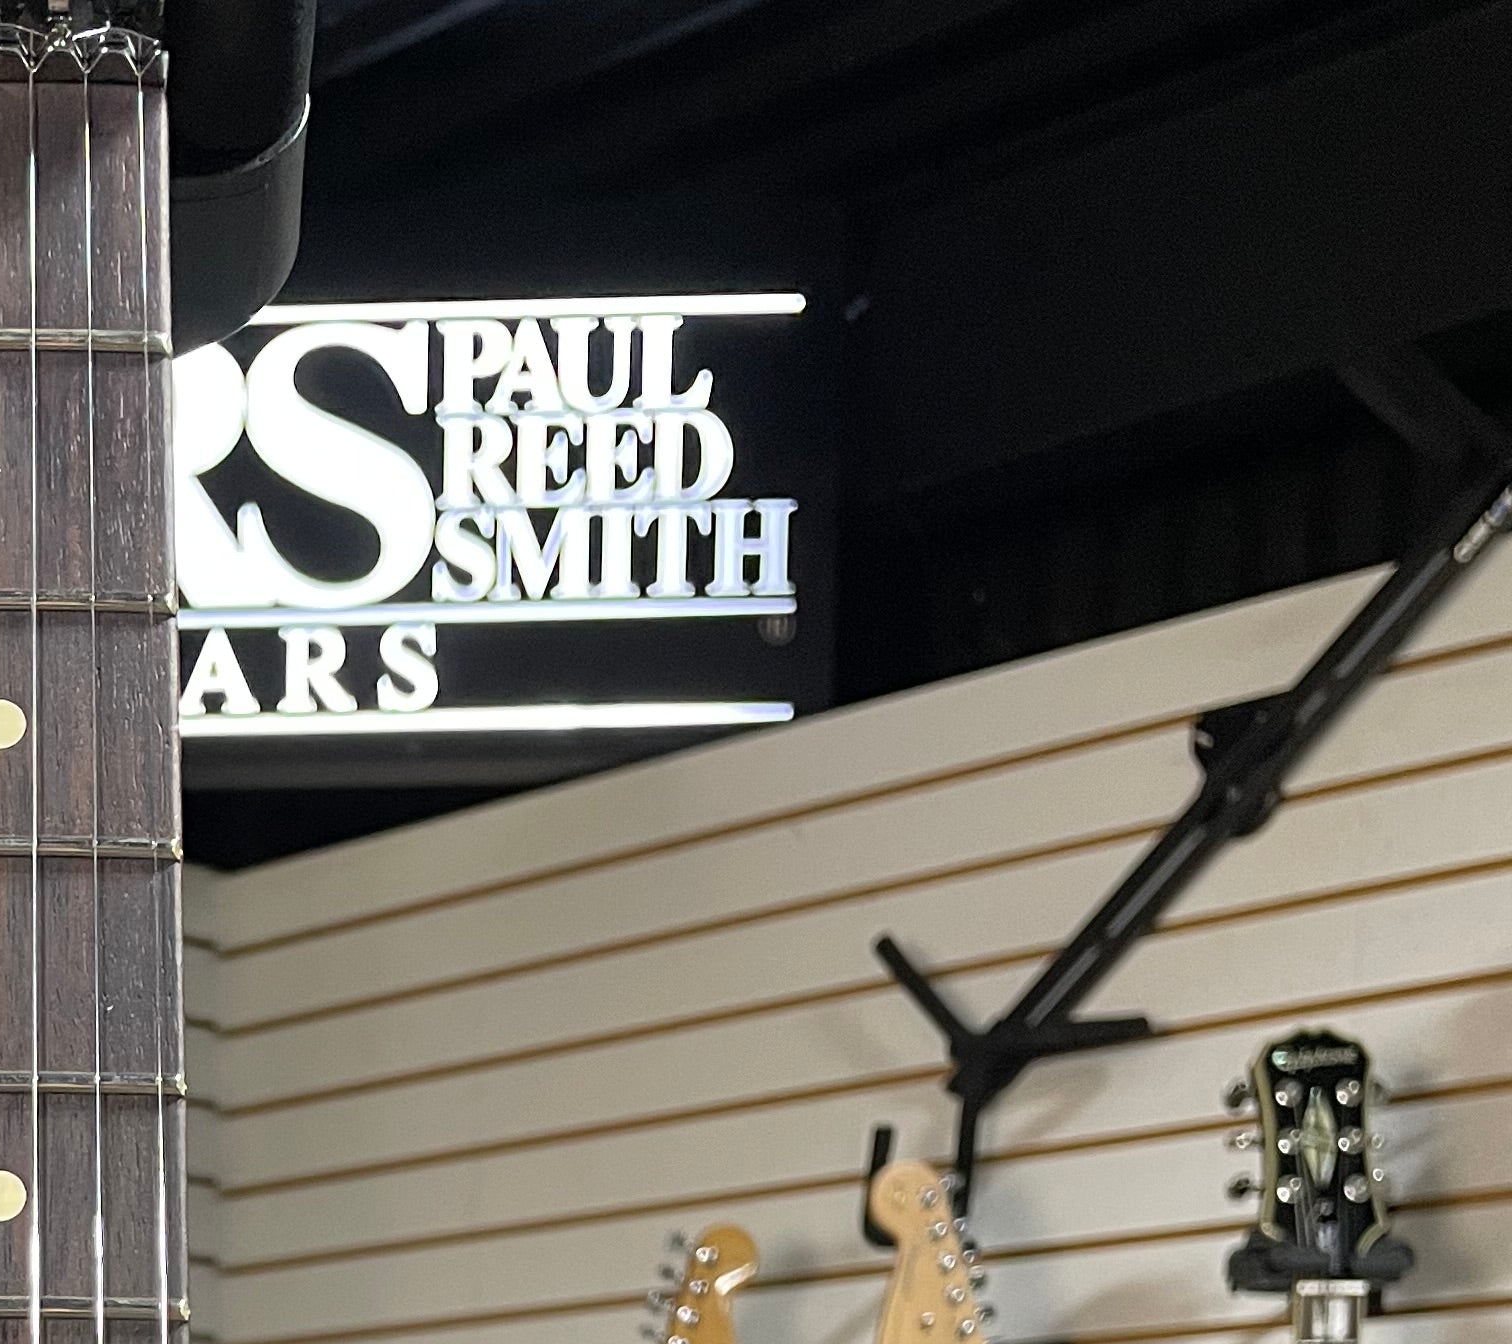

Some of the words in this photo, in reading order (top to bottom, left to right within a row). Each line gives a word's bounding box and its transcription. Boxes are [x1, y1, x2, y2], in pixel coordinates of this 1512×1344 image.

[435, 314, 713, 413] PAUL
[435, 409, 734, 509] REED
[432, 499, 798, 601] SMITH
[178, 625, 438, 715] ARS
